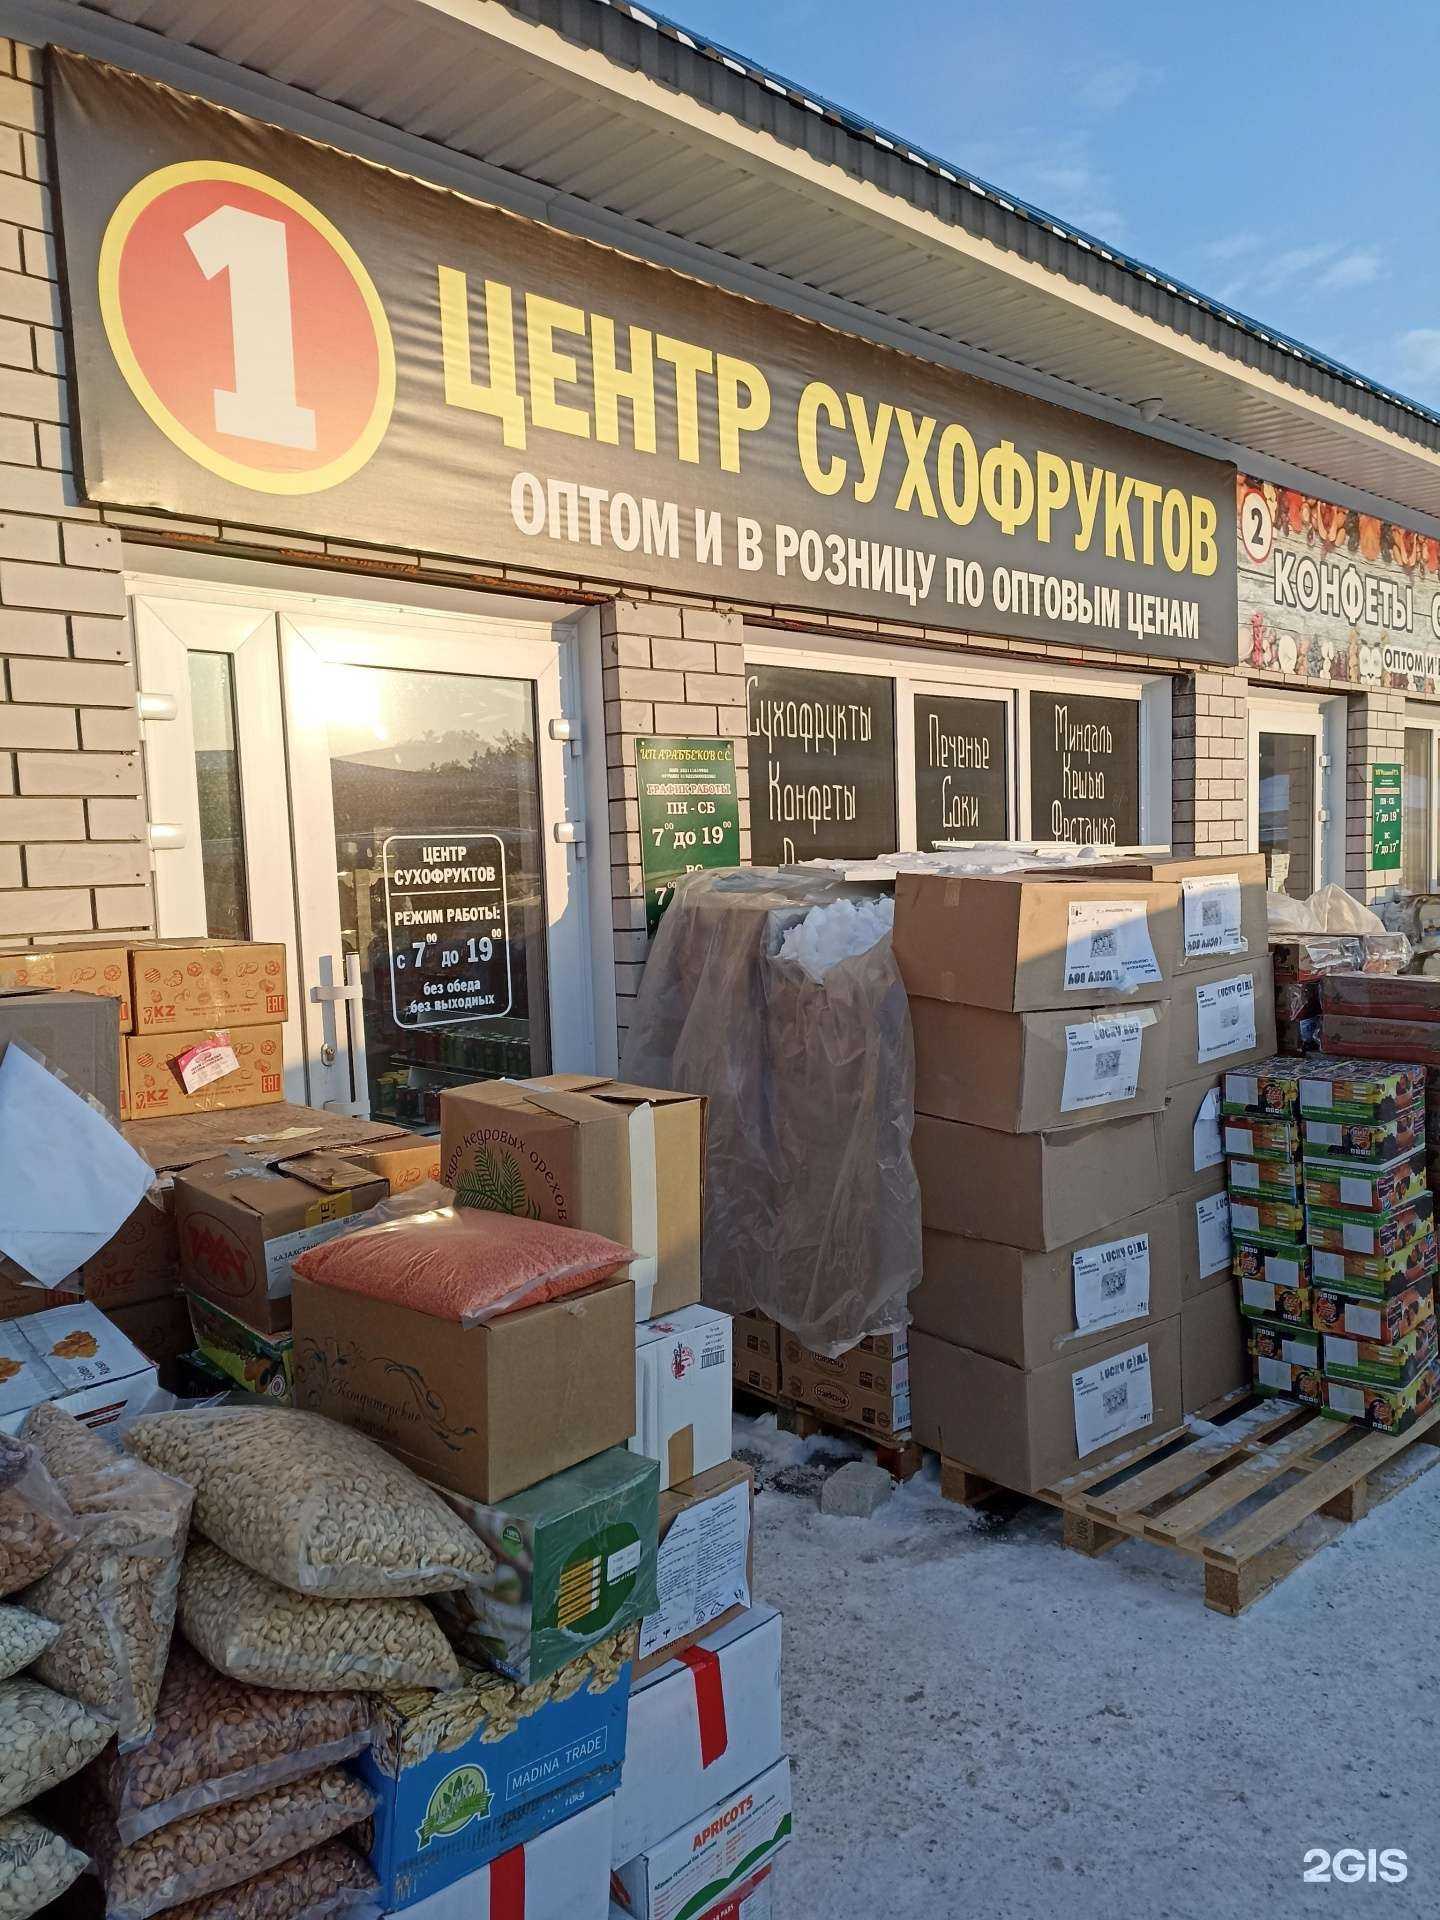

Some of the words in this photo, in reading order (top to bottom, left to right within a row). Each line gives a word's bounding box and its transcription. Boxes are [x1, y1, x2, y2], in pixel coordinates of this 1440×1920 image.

[183, 203, 318, 453] 1
[437, 264, 771, 474] ЦЕНТР
[796, 381, 1220, 577] СУХОФРУКТОВ
[1250, 507, 1264, 546] 2
[510, 471, 680, 559] ОПТОМ
[694, 507, 723, 567] И
[736, 516, 763, 571] В
[775, 523, 936, 606] РОЗНИЦУ
[946, 556, 985, 608] ПО
[992, 566, 1120, 629] ОПТОВЫМ
[1127, 591, 1200, 640] ЦЕНАМ
[1273, 548, 1414, 633] КОНФЕТЫ
[1384, 648, 1423, 673] ОПТОМ
[746, 675, 872, 756] Сухофрукты
[928, 713, 990, 769] Печенье
[1055, 703, 1113, 765] Миндаль
[646, 783, 690, 796] ГРАФИК
[690, 783, 732, 796] РАБОТЫ
[1063, 751, 1104, 799] Кешью
[666, 801, 688, 815] ПН
[697, 800, 716, 815] СБ
[768, 760, 856, 835] Конфеты
[942, 775, 979, 828] Соки
[422, 846, 467, 865] ЦЕНТР
[673, 831, 697, 849] до
[393, 866, 496, 886] СУХОФРУКТОВ
[394, 909, 444, 926] РЕЖИМ
[446, 905, 501, 923] РАБОТЫ:
[441, 949, 459, 968] до
[423, 981, 444, 996] без
[446, 978, 481, 994] обеда
[153, 1005, 176, 1018] KZ
[409, 1000, 432, 1014] без
[434, 993, 495, 1011] выходных
[146, 1088, 169, 1102] KZ
[463, 1128, 526, 1153] кедровых
[529, 1150, 568, 1221] орехов
[1100, 1246, 1126, 1264] LUCKY
[1127, 1240, 1148, 1256] GIRL
[1126, 1352, 1149, 1370] GIRL
[511, 1756, 560, 1790] MADINA
[564, 1735, 602, 1763] TRADE
[692, 1793, 754, 1852] APRICOTS
